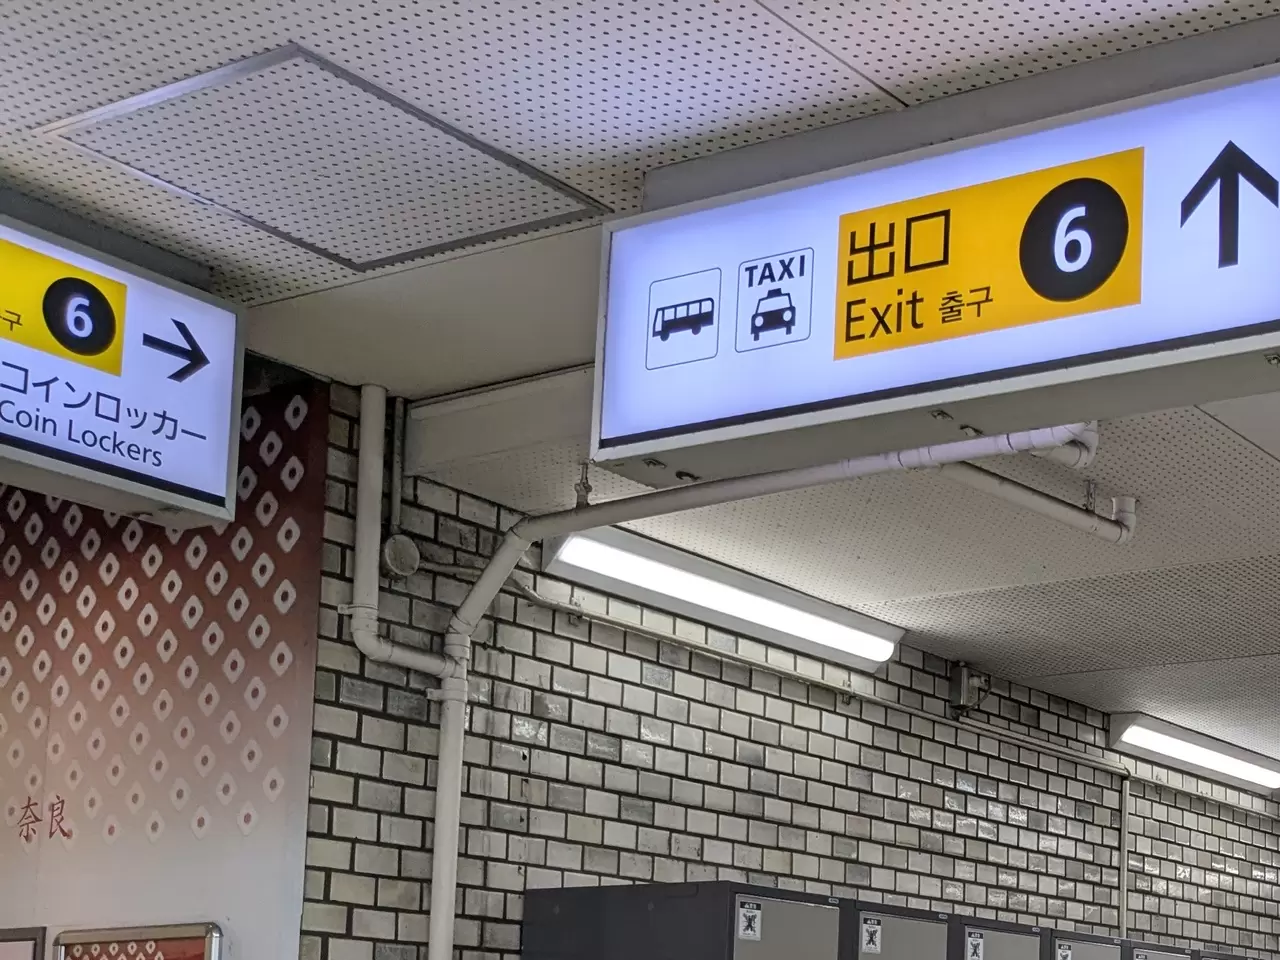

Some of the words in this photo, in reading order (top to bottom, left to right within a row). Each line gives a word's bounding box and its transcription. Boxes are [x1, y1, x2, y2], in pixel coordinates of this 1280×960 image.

[847, 209, 951, 287] 出口
[1054, 206, 1092, 273] 6
[745, 255, 806, 288] TAXI
[0, 309, 23, 331] 구
[65, 296, 94, 338] 6
[845, 288, 924, 343] Exit
[939, 286, 994, 325] 출구
[1, 361, 207, 441] コインロッカー
[0, 400, 58, 437] Coin
[68, 418, 163, 467] Lockers
[17, 794, 69, 842] 奈良
